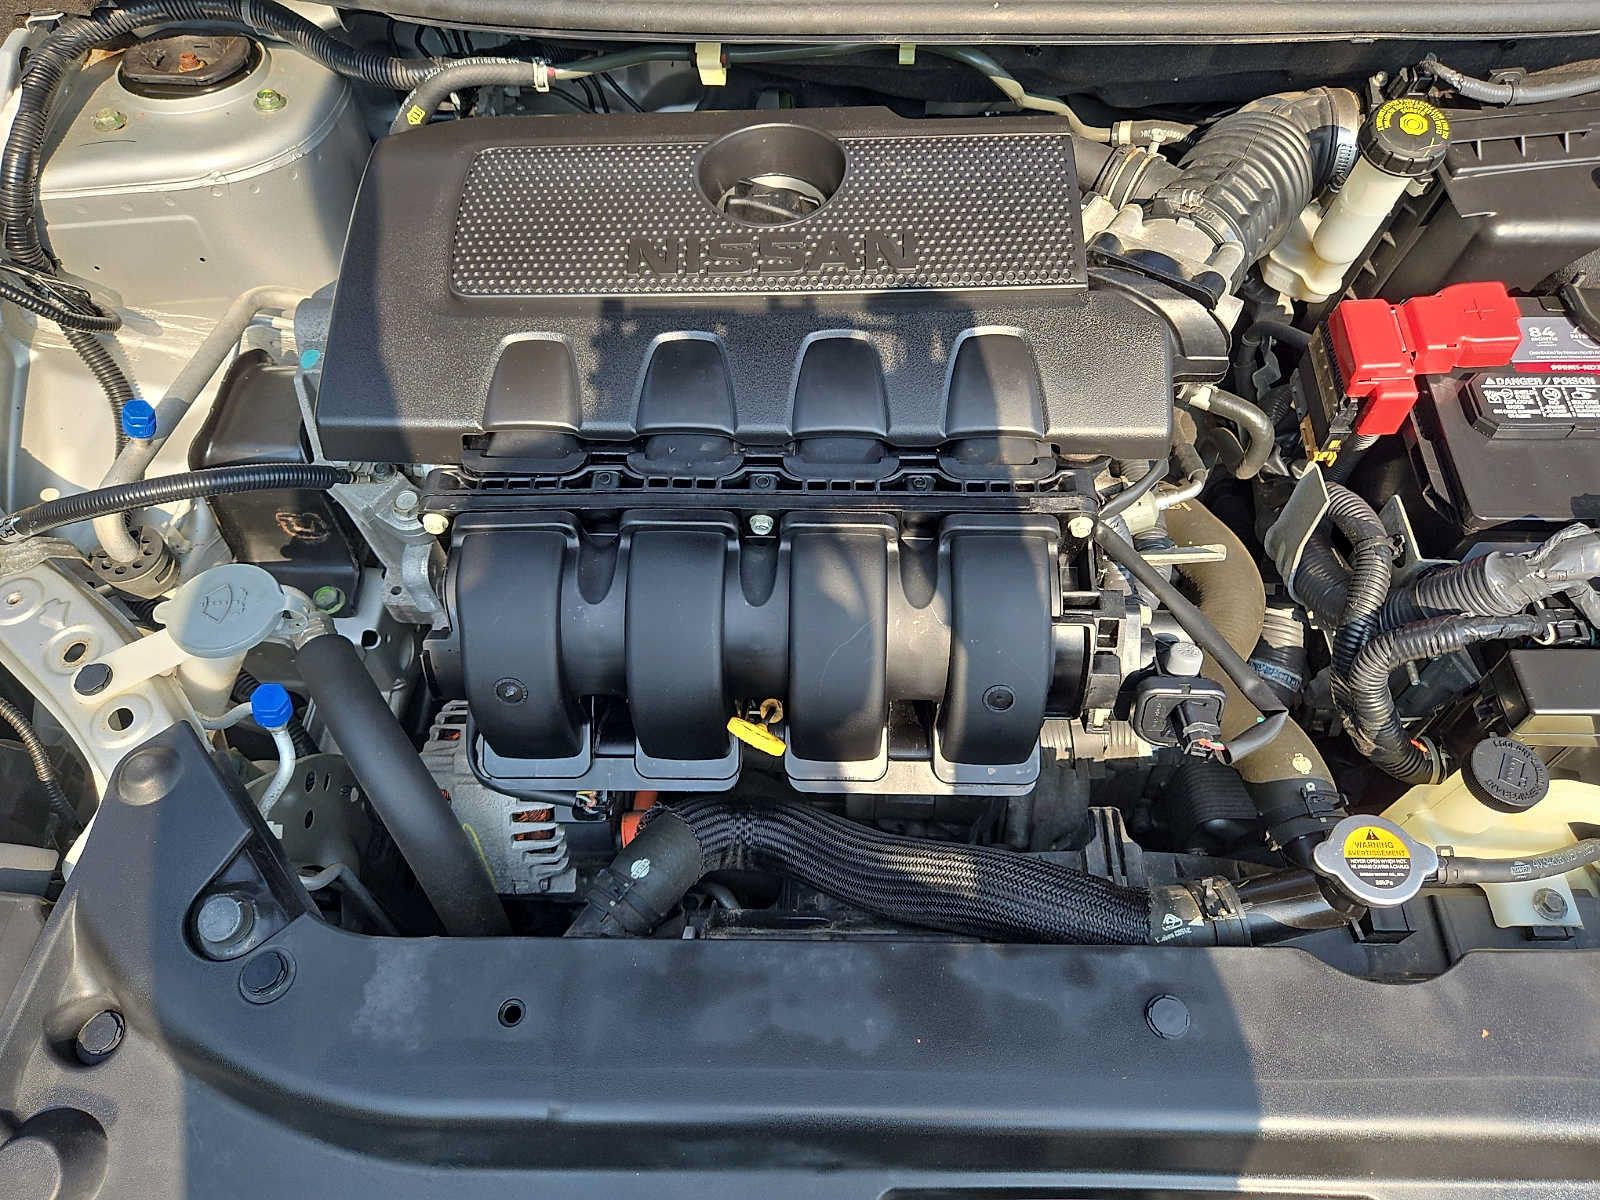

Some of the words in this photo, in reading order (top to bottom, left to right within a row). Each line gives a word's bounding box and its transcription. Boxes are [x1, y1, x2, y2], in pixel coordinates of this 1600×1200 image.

[626, 234, 918, 276] NISSAN
[1528, 326, 1556, 337] 84
[1496, 377, 1543, 386] DANGER
[1552, 377, 1596, 386] POISON
[1353, 841, 1394, 849] WARNING
